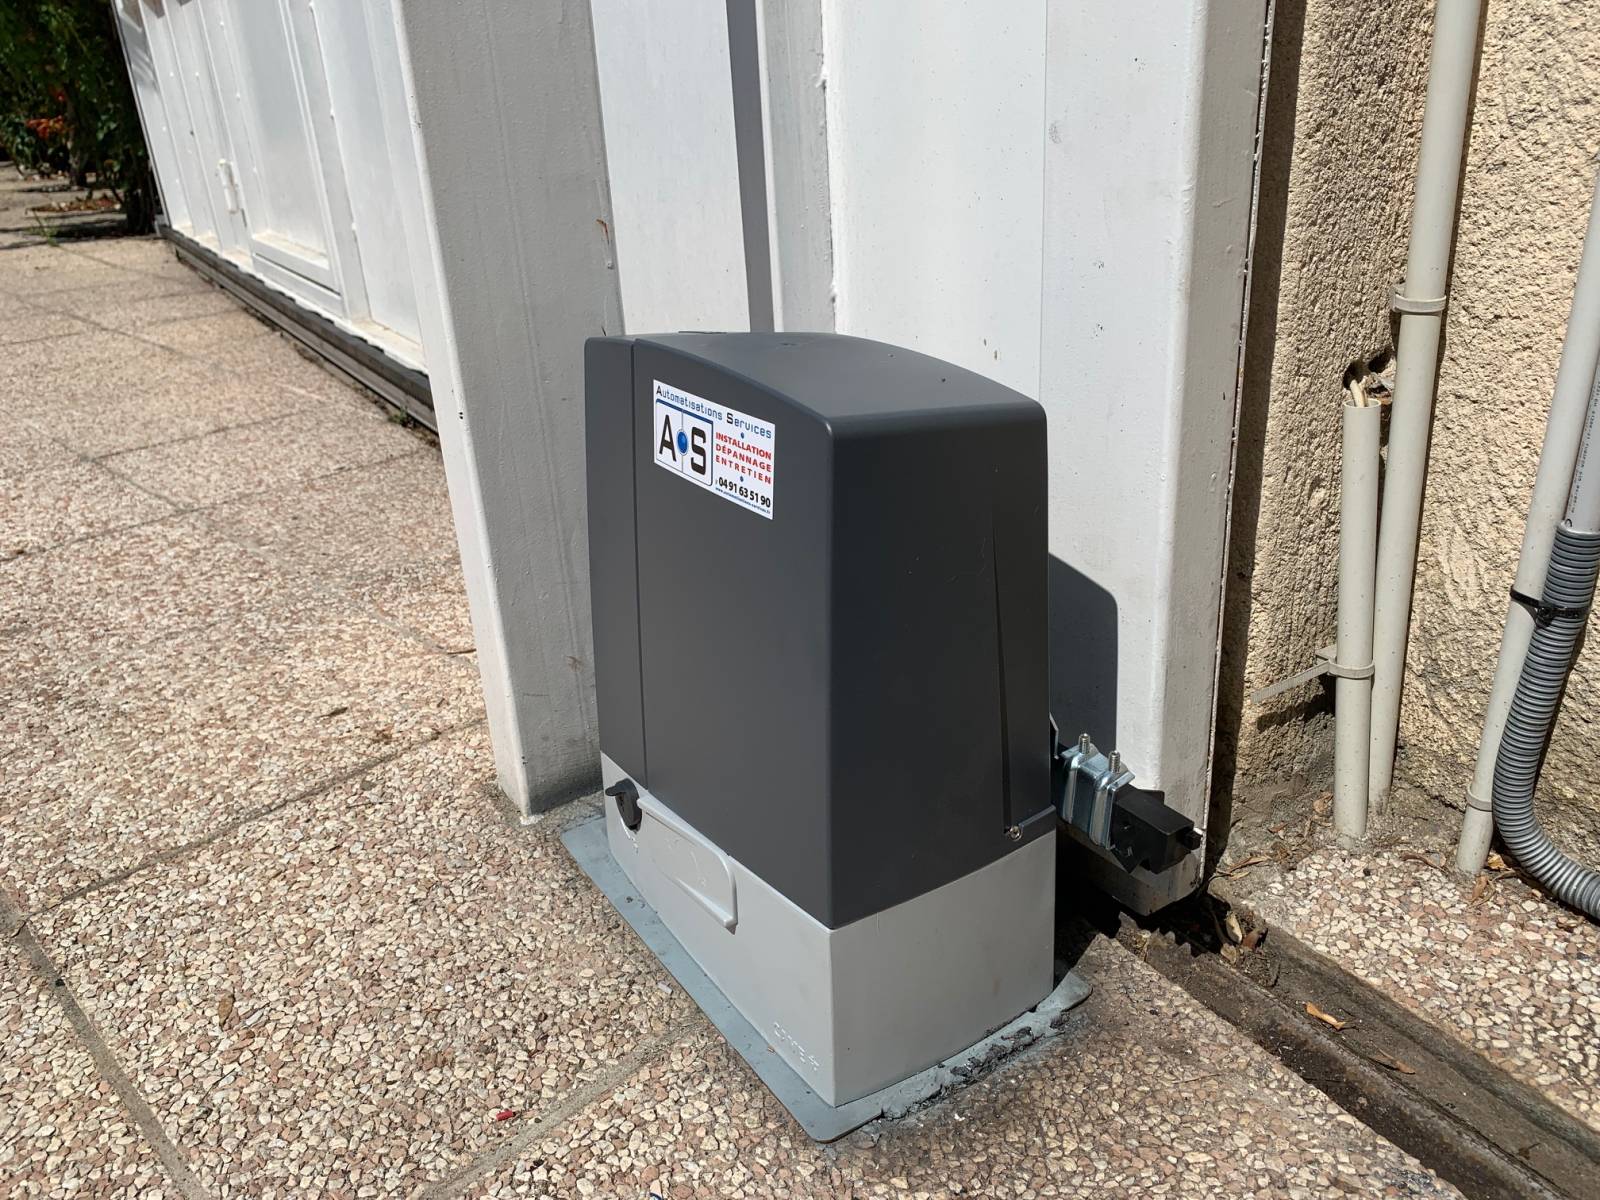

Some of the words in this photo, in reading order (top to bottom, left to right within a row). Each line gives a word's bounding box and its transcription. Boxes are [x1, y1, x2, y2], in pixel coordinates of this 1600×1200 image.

[656, 385, 723, 421] Automatisations
[726, 412, 772, 439] Services
[716, 432, 772, 460] INSTALLATION
[716, 443, 772, 472] DÉPANNAGE
[716, 456, 771, 484] ENTRETIEN
[760, 496, 771, 508] 90
